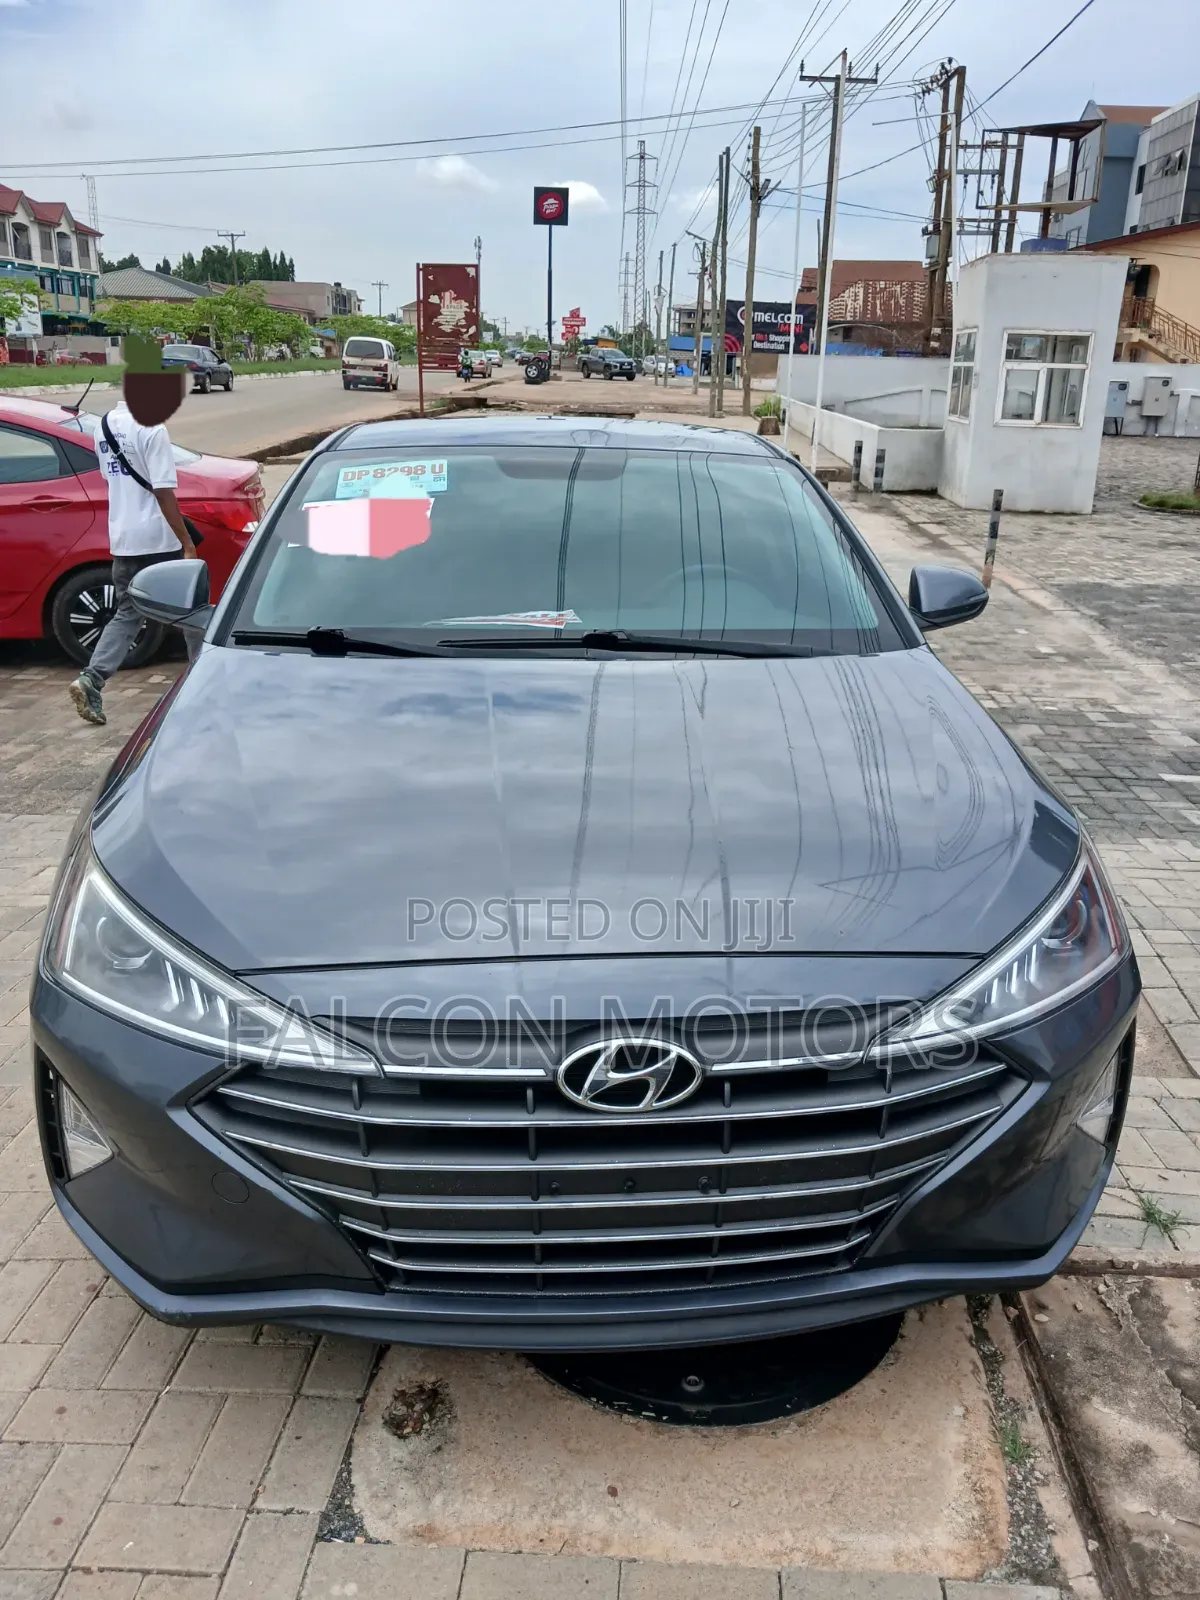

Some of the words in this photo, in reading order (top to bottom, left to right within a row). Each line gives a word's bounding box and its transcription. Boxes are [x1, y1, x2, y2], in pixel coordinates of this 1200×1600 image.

[780, 324, 803, 332] MNI
[343, 470, 370, 481] DP
[431, 463, 444, 474] U
